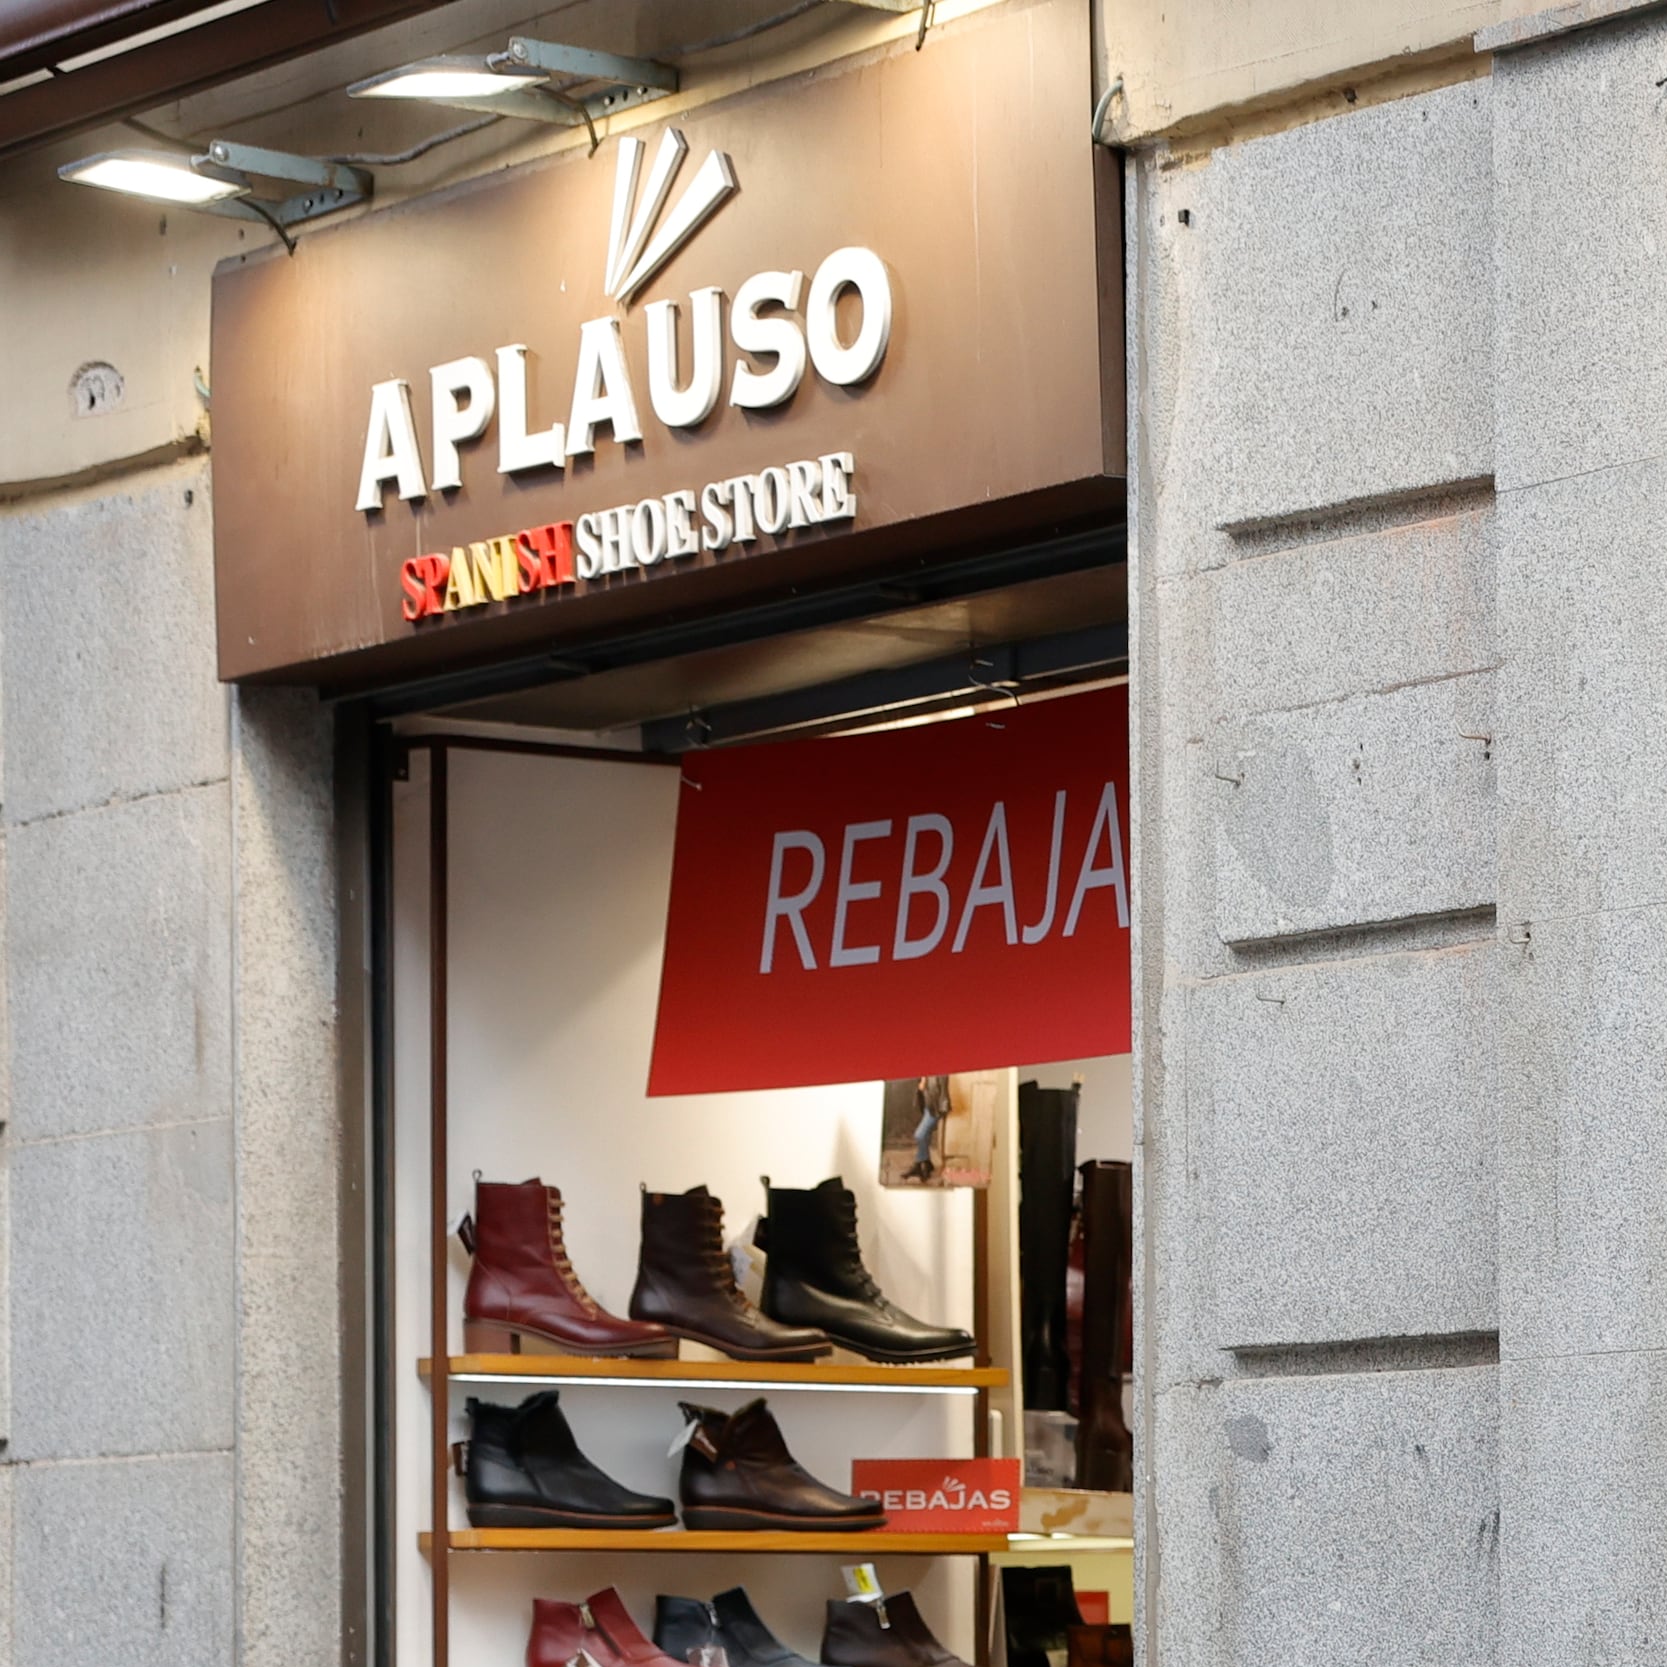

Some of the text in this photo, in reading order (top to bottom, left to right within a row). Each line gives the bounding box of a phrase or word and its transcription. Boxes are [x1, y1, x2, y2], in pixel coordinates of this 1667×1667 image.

[355, 246, 893, 513] APLAUSO
[401, 451, 857, 622] SPANISH SHOE STORE
[759, 780, 1132, 975] REBAJA
